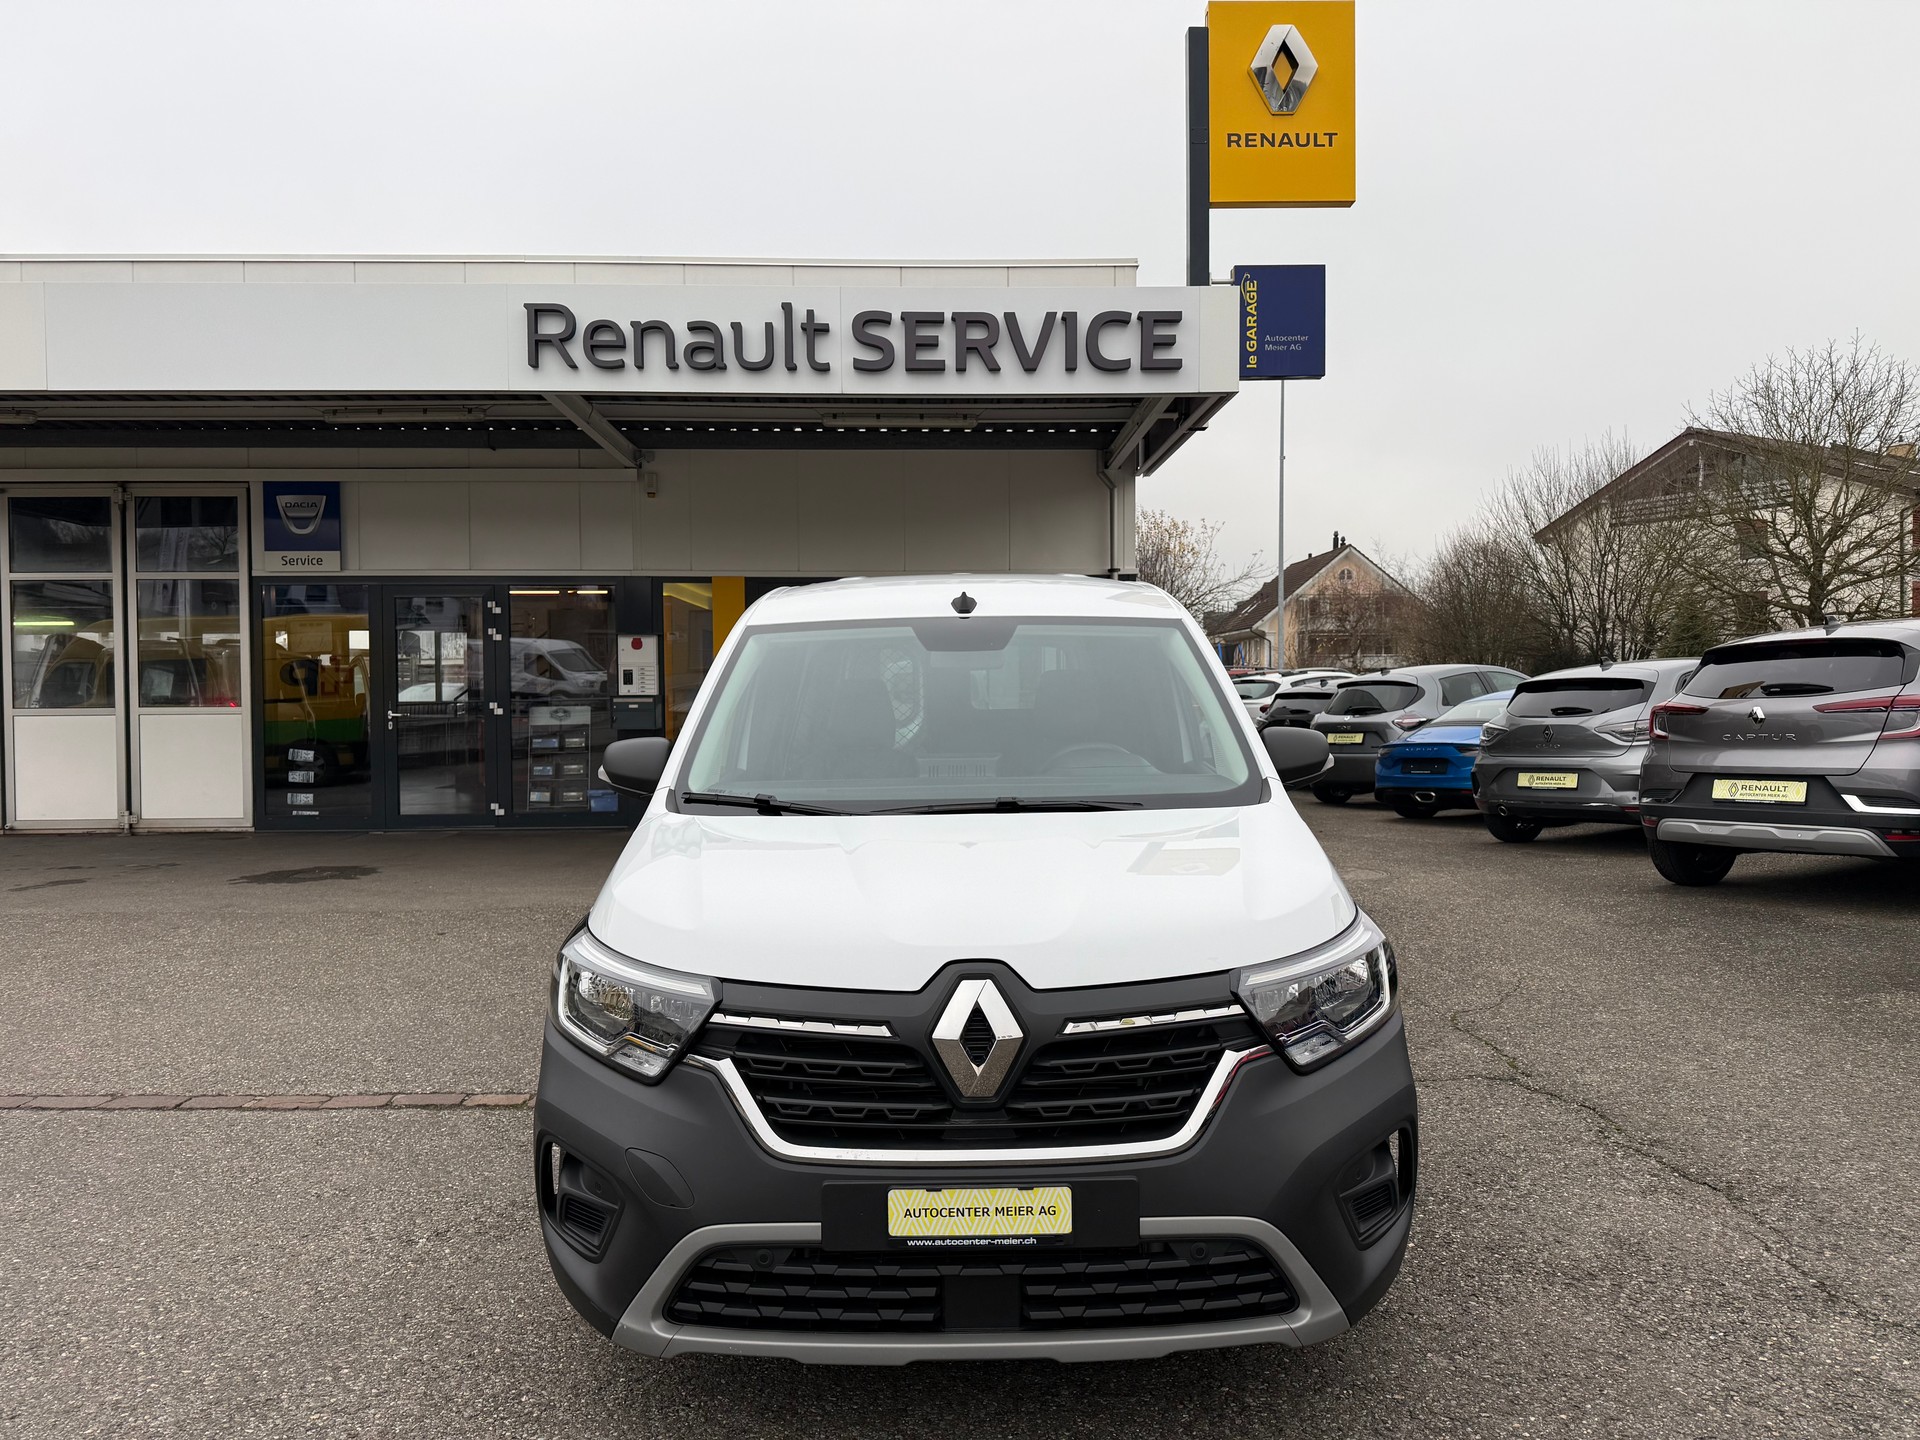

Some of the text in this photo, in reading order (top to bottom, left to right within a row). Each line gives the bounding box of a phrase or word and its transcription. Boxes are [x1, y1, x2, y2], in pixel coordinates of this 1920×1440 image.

[1226, 132, 1338, 148] RENAULT
[1246, 279, 1257, 369] le GARAGE
[523, 302, 1183, 372] Renault SERVICE
[1264, 334, 1309, 342] Autocenter
[1290, 343, 1302, 351] AG
[284, 501, 318, 509] DACIA
[281, 555, 323, 566] Service
[1722, 733, 1797, 741] CAPTUR
[1740, 784, 1789, 792] RENAULT
[904, 1206, 1057, 1218] AUTOCENTER MEIER AG
[907, 1237, 1037, 1246] www.autocenter-meier.ch
